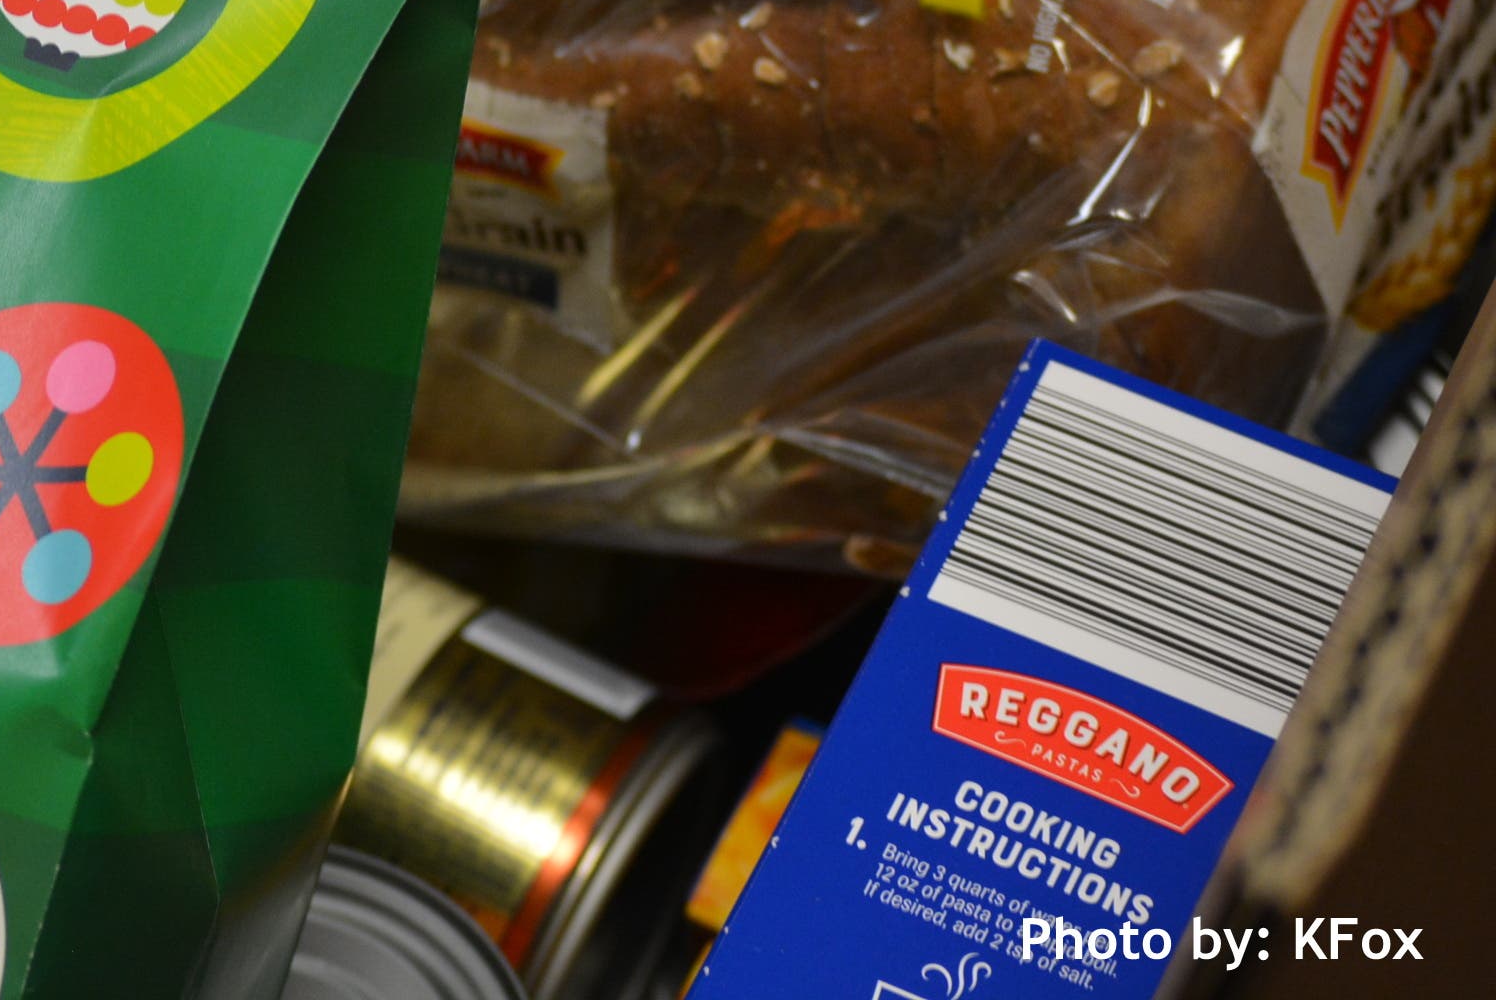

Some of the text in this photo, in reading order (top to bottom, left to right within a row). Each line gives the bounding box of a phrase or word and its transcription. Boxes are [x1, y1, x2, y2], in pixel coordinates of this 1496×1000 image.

[1026, 42, 1053, 73] NO
[961, 682, 1202, 805] REGGANO
[1031, 742, 1104, 786] PASTAS
[845, 816, 868, 851] 1.
[882, 842, 930, 880] Bring
[933, 865, 946, 882] 3
[948, 872, 1006, 907] quarts
[1008, 898, 1030, 916] of
[887, 793, 1155, 926] INSTRUCTIONS
[954, 779, 1122, 871] COOKING
[863, 879, 879, 897] If
[880, 887, 948, 930] desired,
[952, 915, 987, 944] add
[989, 934, 1004, 950] 2
[1037, 954, 1057, 974] of
[1057, 964, 1095, 991] salt.
[876, 863, 895, 881] 12
[897, 874, 919, 892] oz
[922, 882, 942, 901] of
[941, 893, 992, 925] pasta
[995, 913, 1014, 932] to
